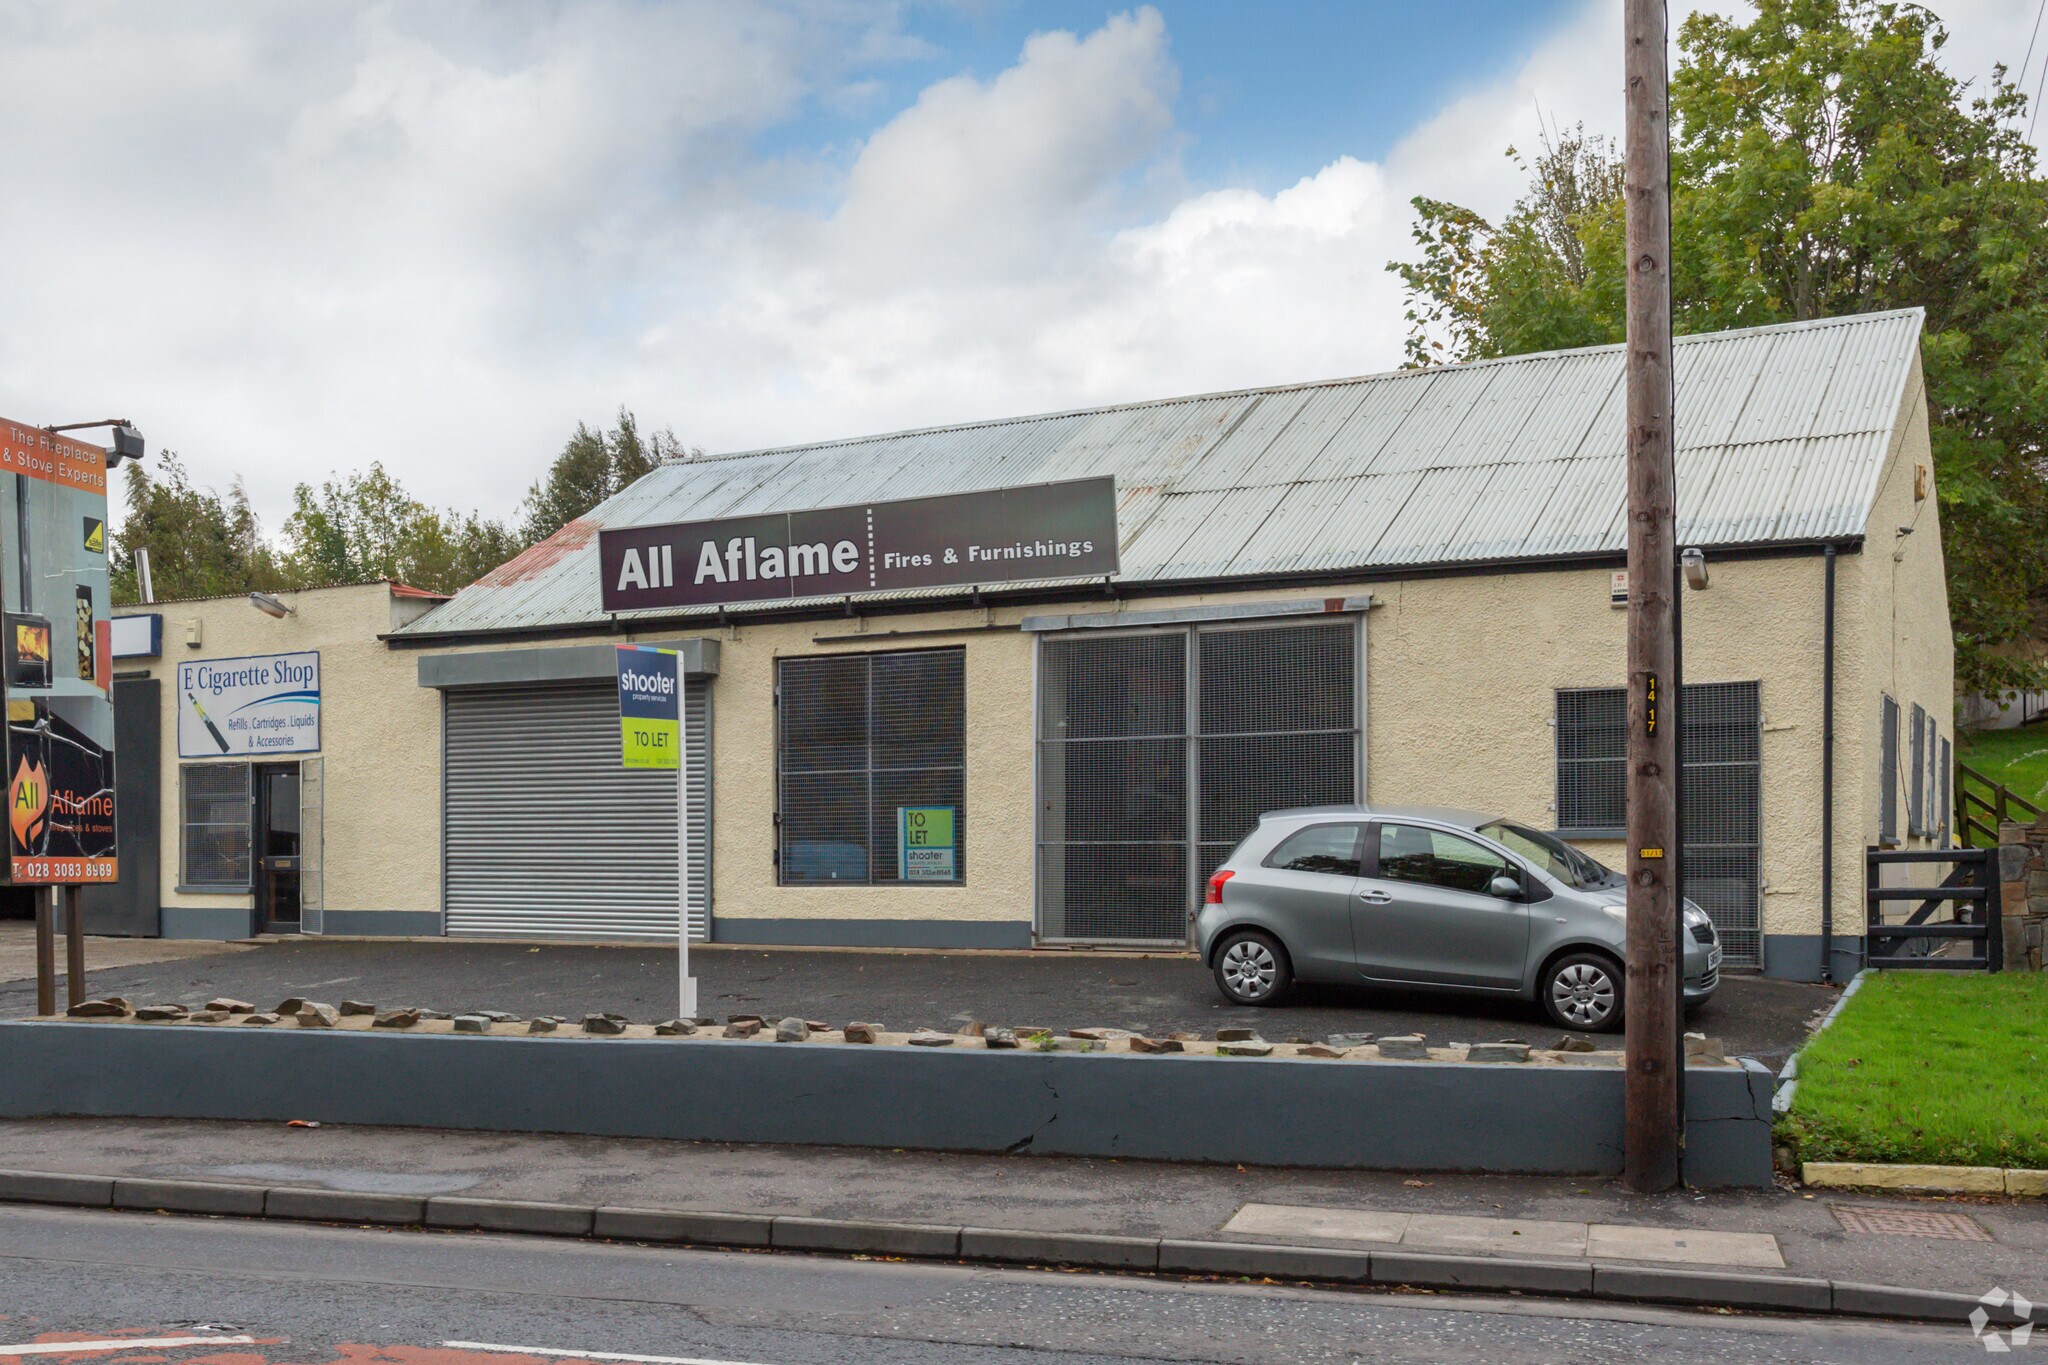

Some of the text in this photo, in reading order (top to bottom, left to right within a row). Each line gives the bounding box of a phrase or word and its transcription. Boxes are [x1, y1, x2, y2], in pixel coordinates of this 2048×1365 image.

[10, 427, 97, 464] The Fireplace
[3, 447, 104, 487] & Stove Experts
[617, 536, 1095, 591] All Aflame Fires & Furnishings
[184, 660, 314, 696] E Cigarette Shop
[621, 669, 675, 695] shooter
[228, 713, 315, 731] Refills Cartridges Liquids
[249, 733, 294, 747] & Accessories
[634, 731, 669, 748] TO LET
[15, 781, 39, 810] All
[51, 789, 113, 817] Aflame
[91, 824, 113, 833] stoves
[908, 812, 926, 827] TO
[909, 830, 928, 845] LET
[908, 851, 943, 860] shooter
[27, 863, 49, 877] 028
[54, 863, 82, 877] 3083
[86, 863, 113, 878] 8989
